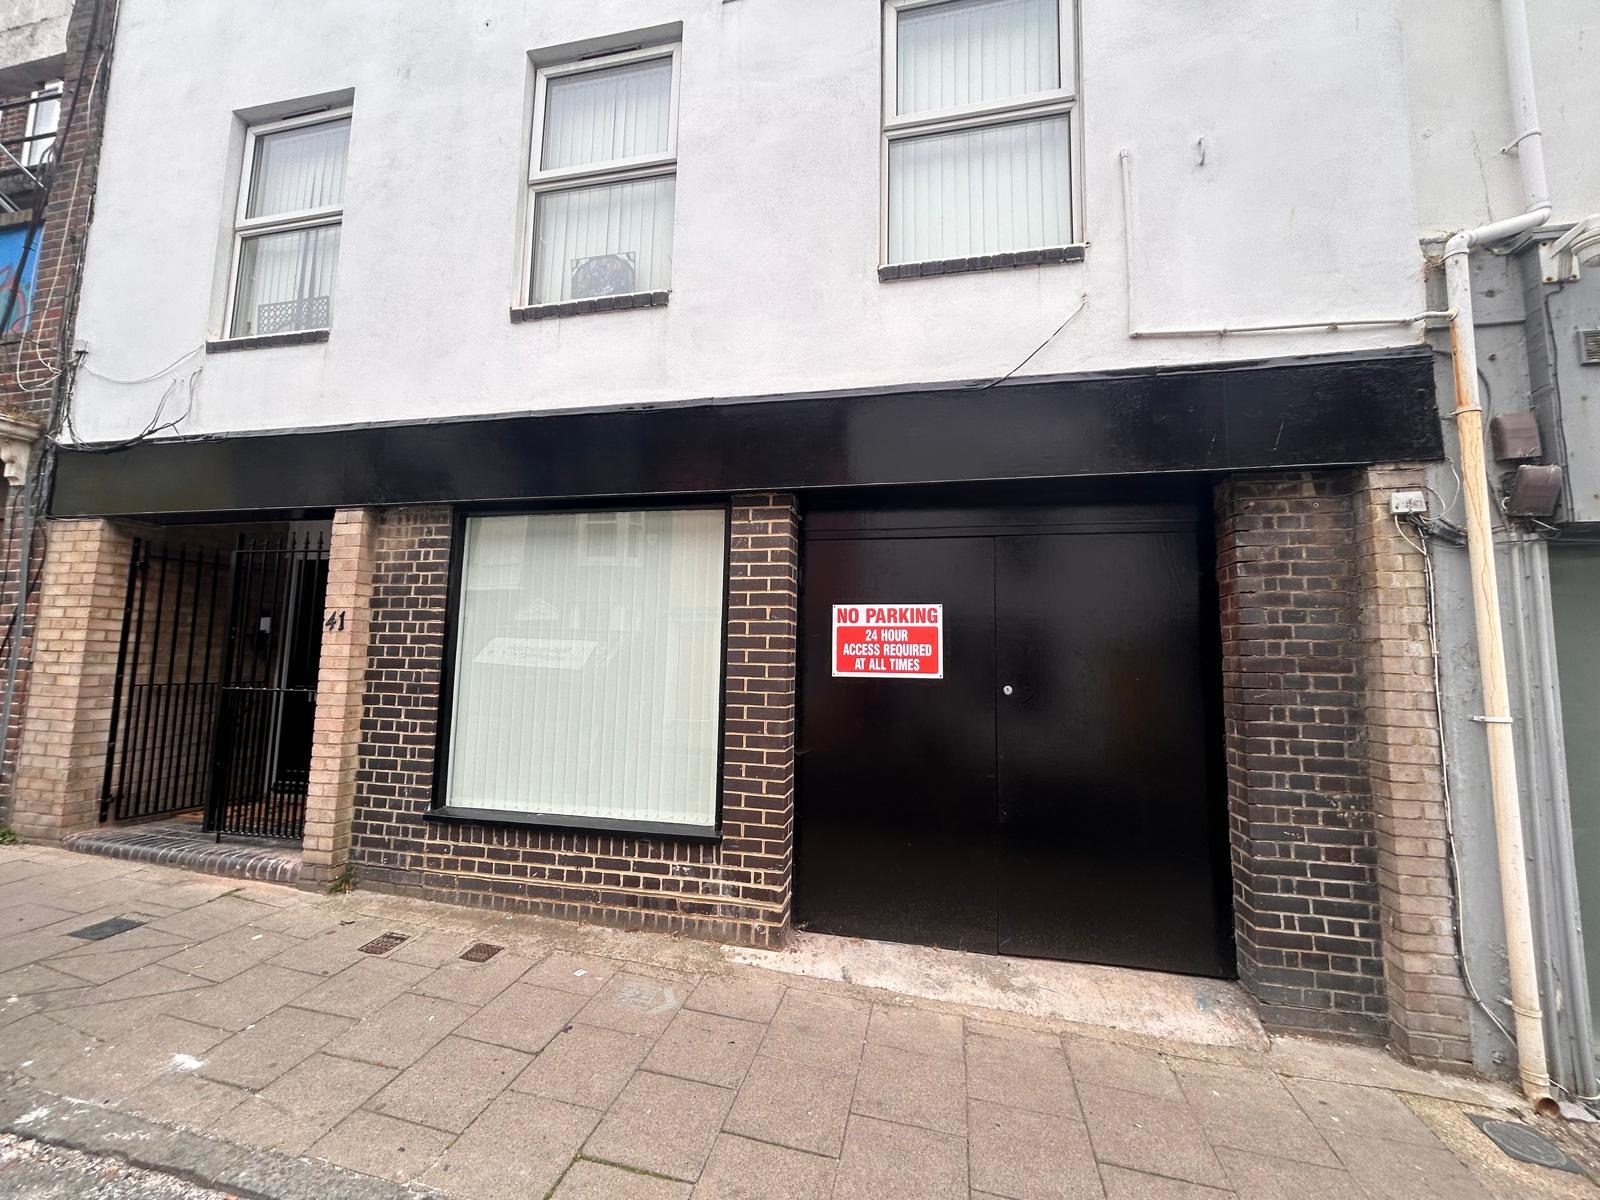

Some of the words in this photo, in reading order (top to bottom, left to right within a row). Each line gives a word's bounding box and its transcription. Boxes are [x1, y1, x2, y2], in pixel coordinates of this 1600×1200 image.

[325, 610, 346, 632] 41
[837, 608, 859, 623] NO
[866, 608, 938, 623] PARKING
[865, 629, 878, 641] 24
[881, 629, 908, 641] HOUR
[843, 643, 880, 656] ACCESS
[883, 644, 932, 657] REQUIRED
[854, 658, 866, 670] AT
[868, 658, 887, 670] ALL
[889, 658, 920, 671] TIMES
